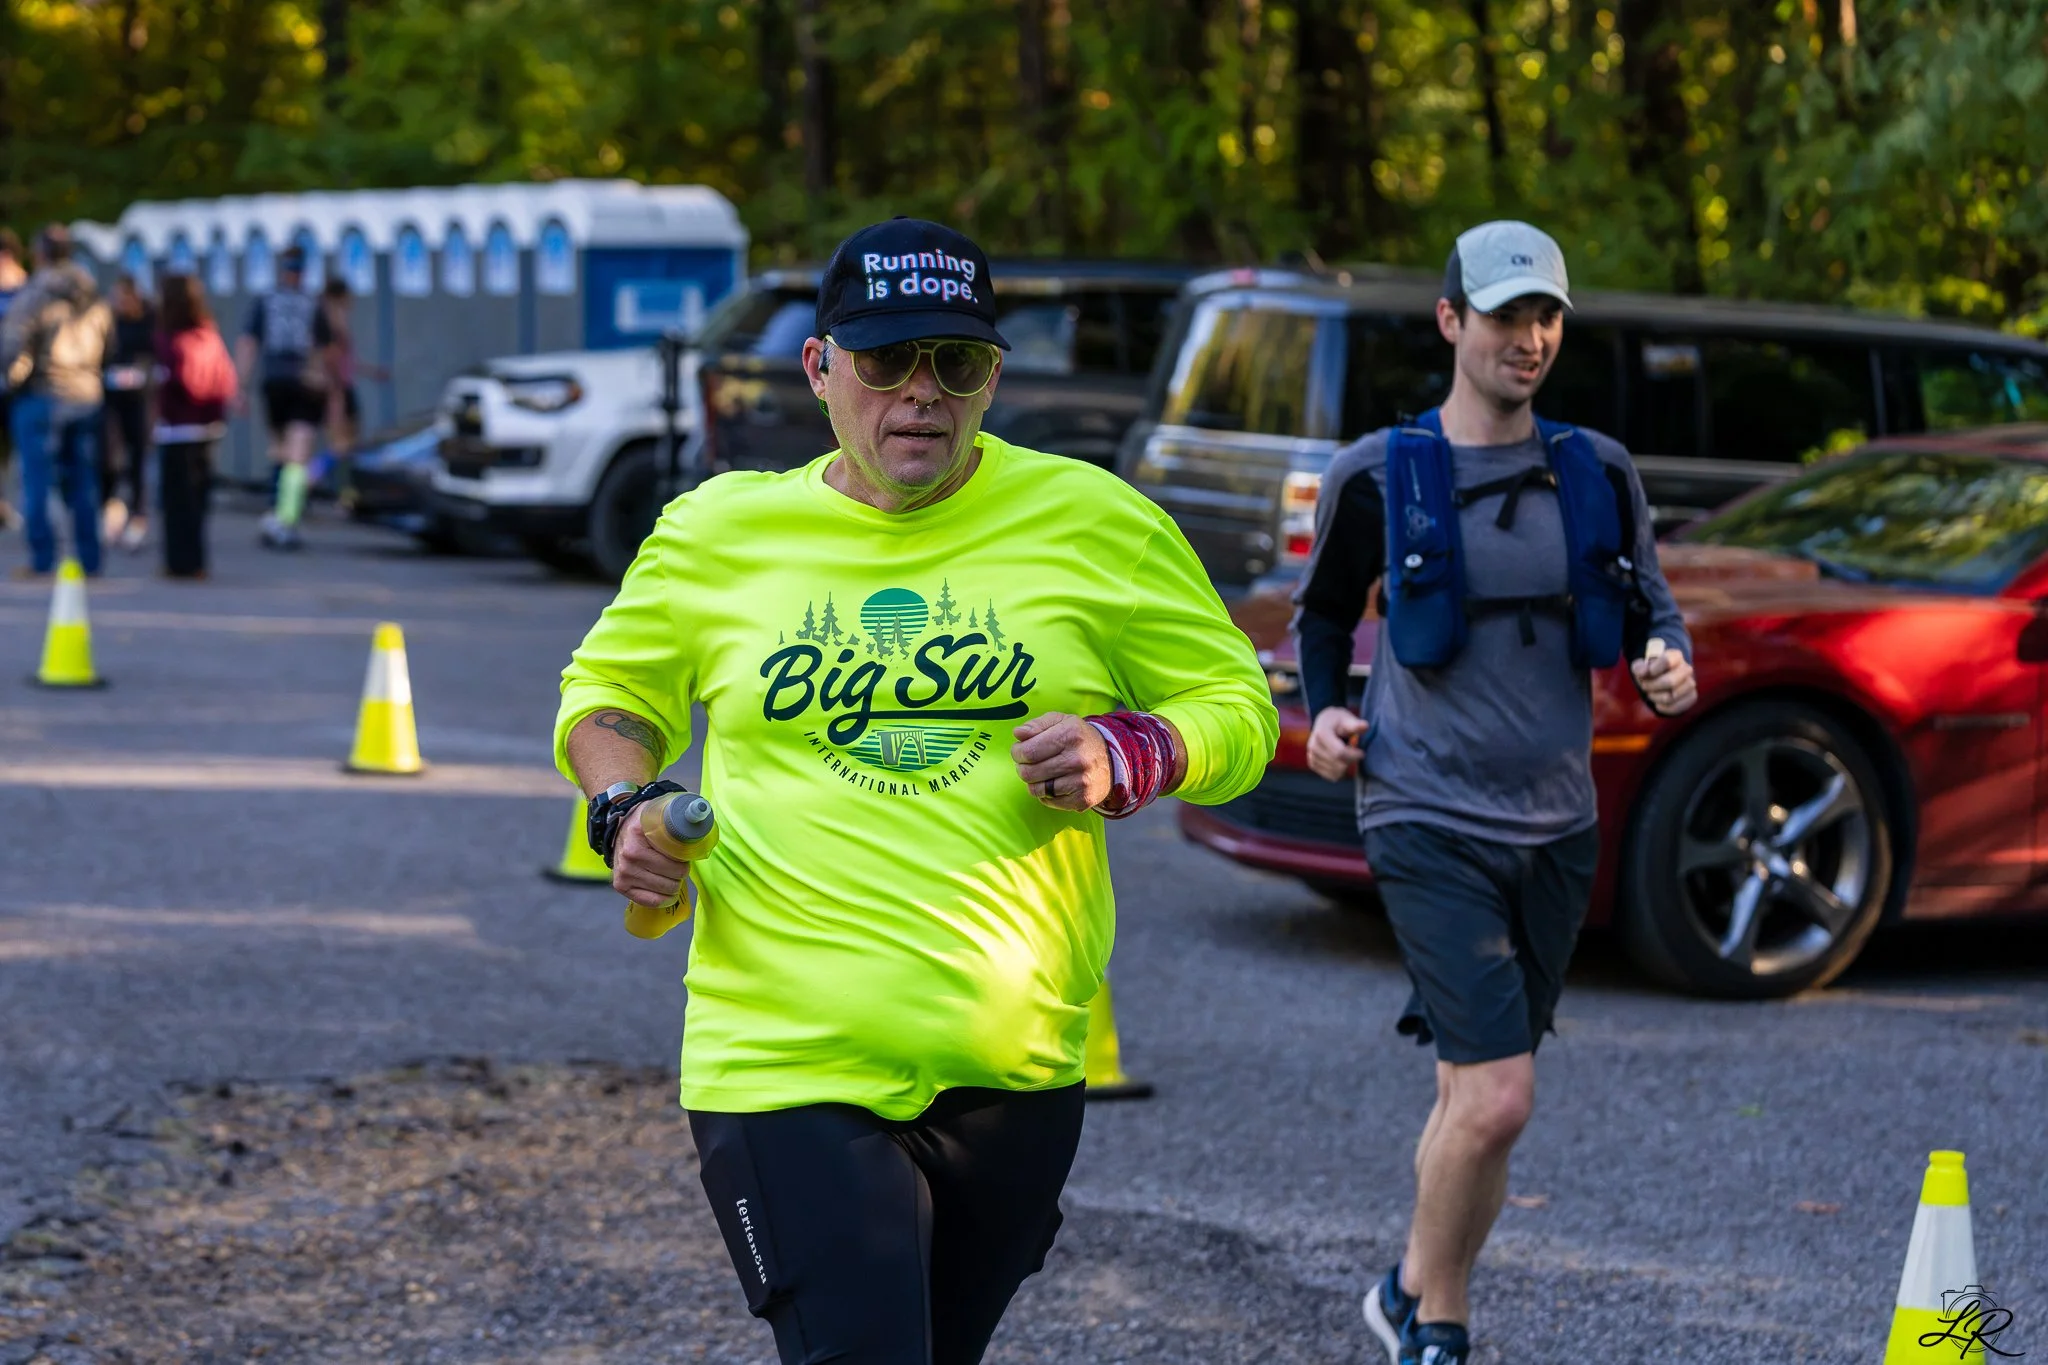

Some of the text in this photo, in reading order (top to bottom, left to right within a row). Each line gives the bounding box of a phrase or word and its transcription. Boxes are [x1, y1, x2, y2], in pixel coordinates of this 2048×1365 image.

[864, 248, 976, 282] Running
[867, 272, 979, 303] is dope.
[760, 633, 1037, 746] Big Sur
[804, 730, 993, 796] INTERNATIONAL MARATHON
